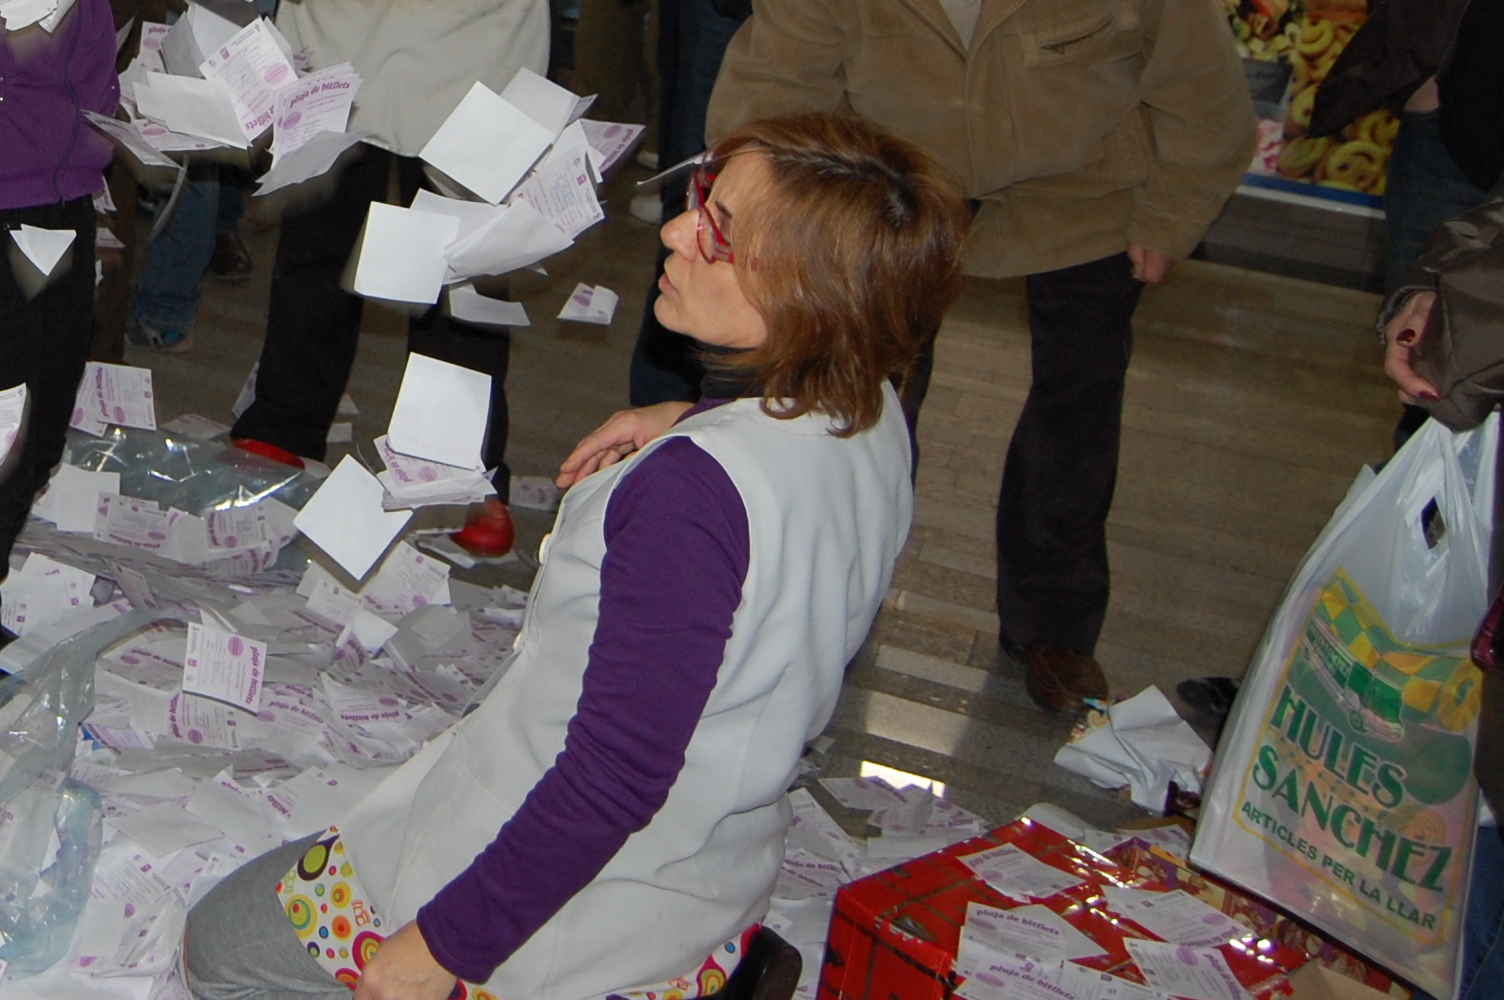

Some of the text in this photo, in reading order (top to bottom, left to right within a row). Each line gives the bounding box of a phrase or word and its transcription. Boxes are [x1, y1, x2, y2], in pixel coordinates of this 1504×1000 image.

[320, 80, 351, 92] bitllets
[249, 645, 261, 668] pluja
[246, 677, 260, 704] bitllets
[1252, 744, 1453, 892] SANCHEZ
[1242, 801, 1437, 931] ARTICLES PER LA LLAR
[976, 908, 1060, 937] pluja de bitllets
[990, 964, 1020, 981] pluja
[1021, 972, 1036, 983] de
